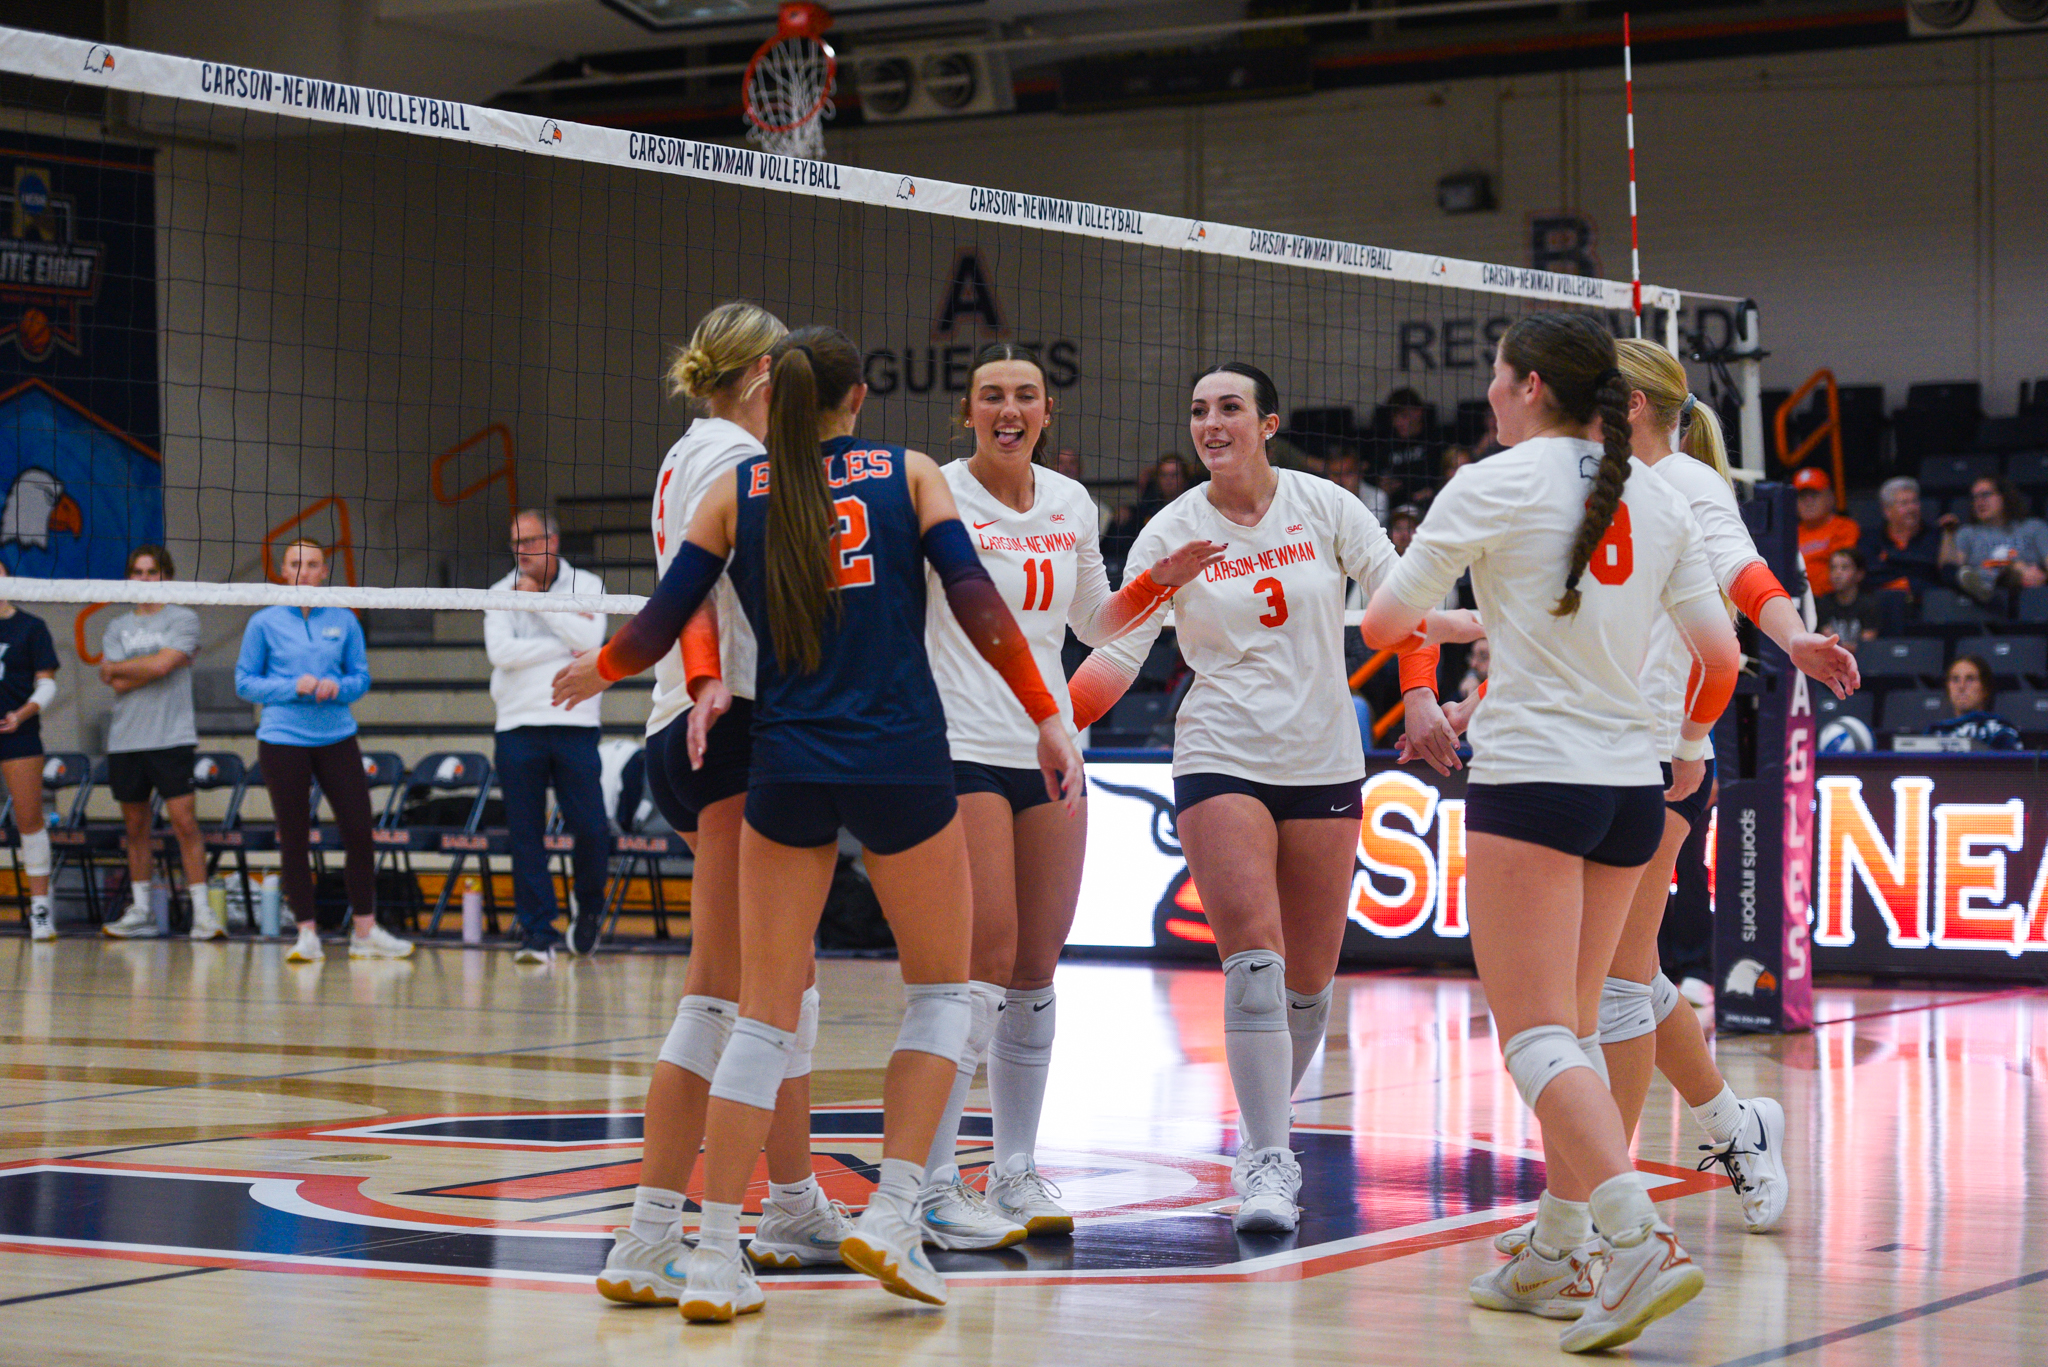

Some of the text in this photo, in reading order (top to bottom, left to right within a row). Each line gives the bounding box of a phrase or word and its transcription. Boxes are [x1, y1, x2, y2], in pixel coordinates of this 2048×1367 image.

[202, 62, 471, 132] CARSON-NEWMAN VOLLEYBALL
[629, 132, 841, 190] CARSON-NEWMAN VOLLEYBALL
[970, 187, 1144, 235] CARSON-NEWMAN VOLLEYBALL
[1250, 230, 1393, 271] CARSON-NEWMAN VOLLEYBALL
[936, 253, 1004, 335] A
[748, 450, 892, 498] ELES
[978, 531, 1077, 554] CARSON-NEWMAN
[1286, 524, 1303, 533] SAC
[1585, 497, 1634, 586] 8
[1022, 558, 1055, 611] 11
[1204, 541, 1316, 583] CARSON-NEWMAN
[1253, 576, 1289, 628] 3
[1787, 597, 1812, 981] AGLES
[1738, 808, 1758, 942] sports imports
